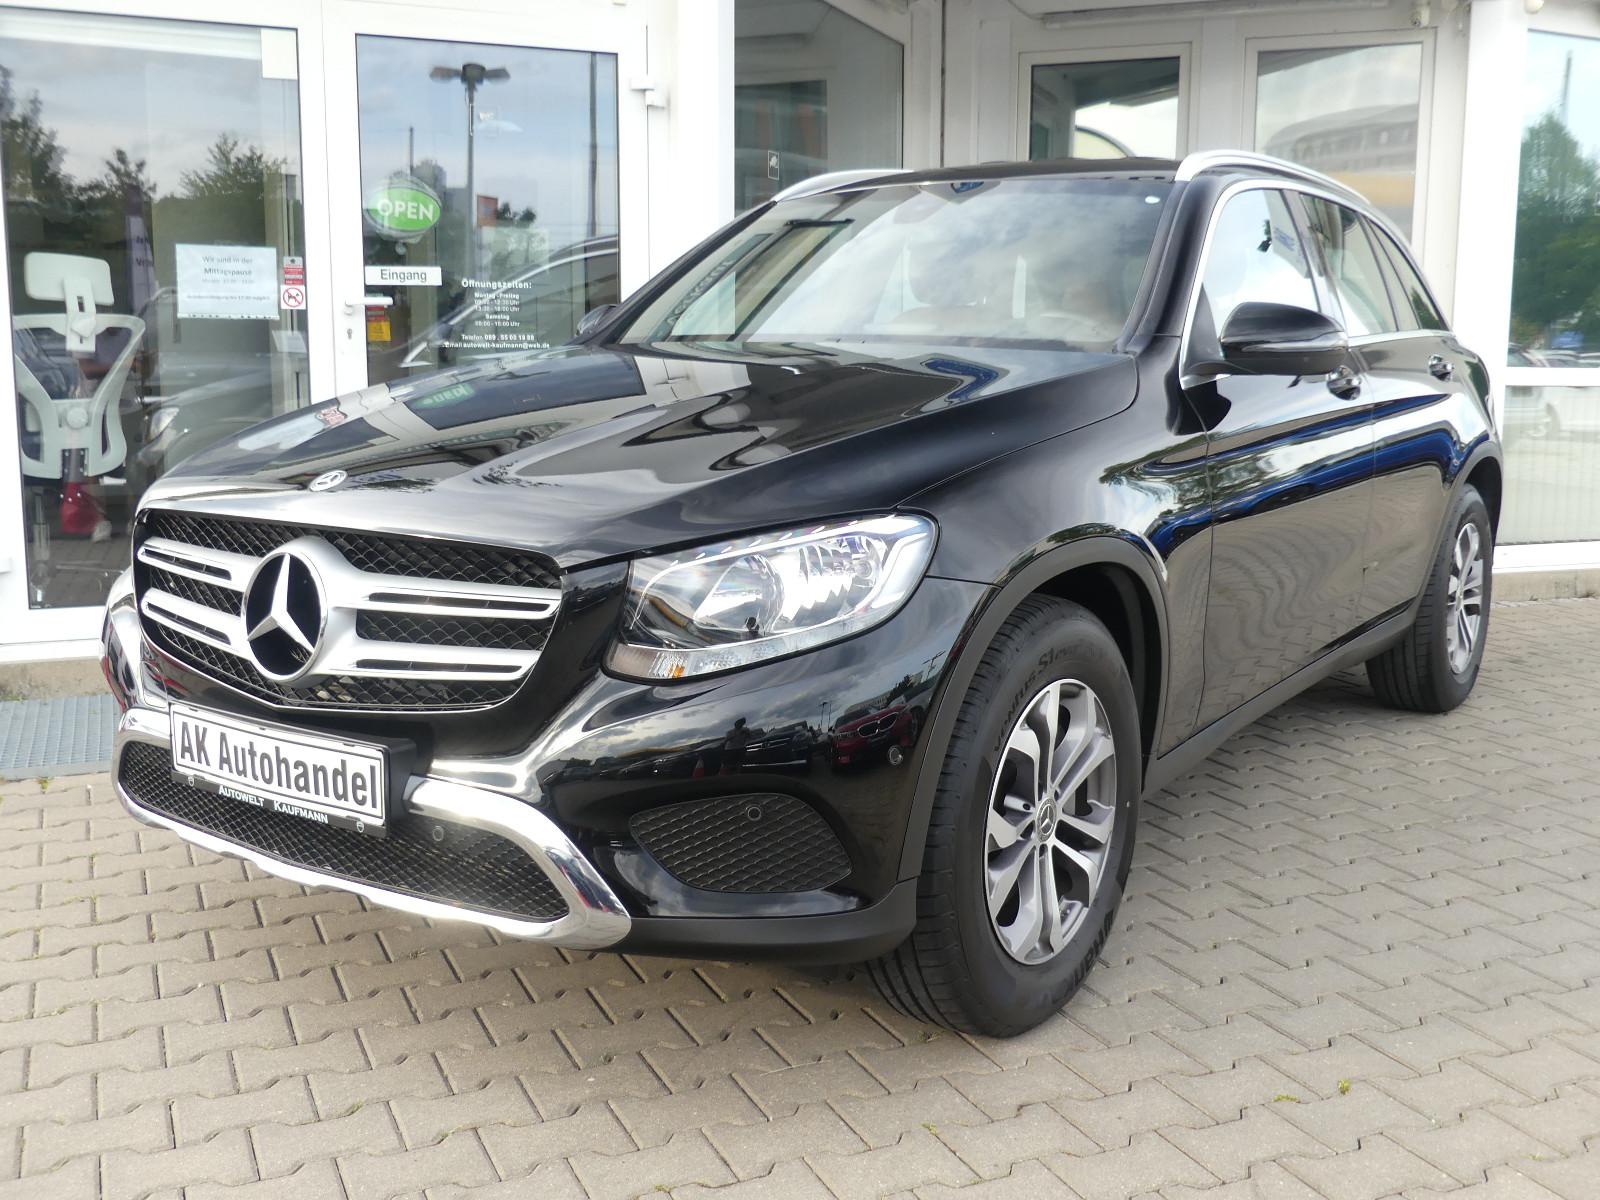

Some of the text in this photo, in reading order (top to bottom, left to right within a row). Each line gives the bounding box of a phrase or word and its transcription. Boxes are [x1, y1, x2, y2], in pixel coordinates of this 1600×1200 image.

[377, 200, 434, 222] OPEN
[380, 269, 427, 283] Eingang
[180, 721, 378, 809] AK Autohandel
[218, 784, 329, 825] AUTOWELT KAUFMANN
